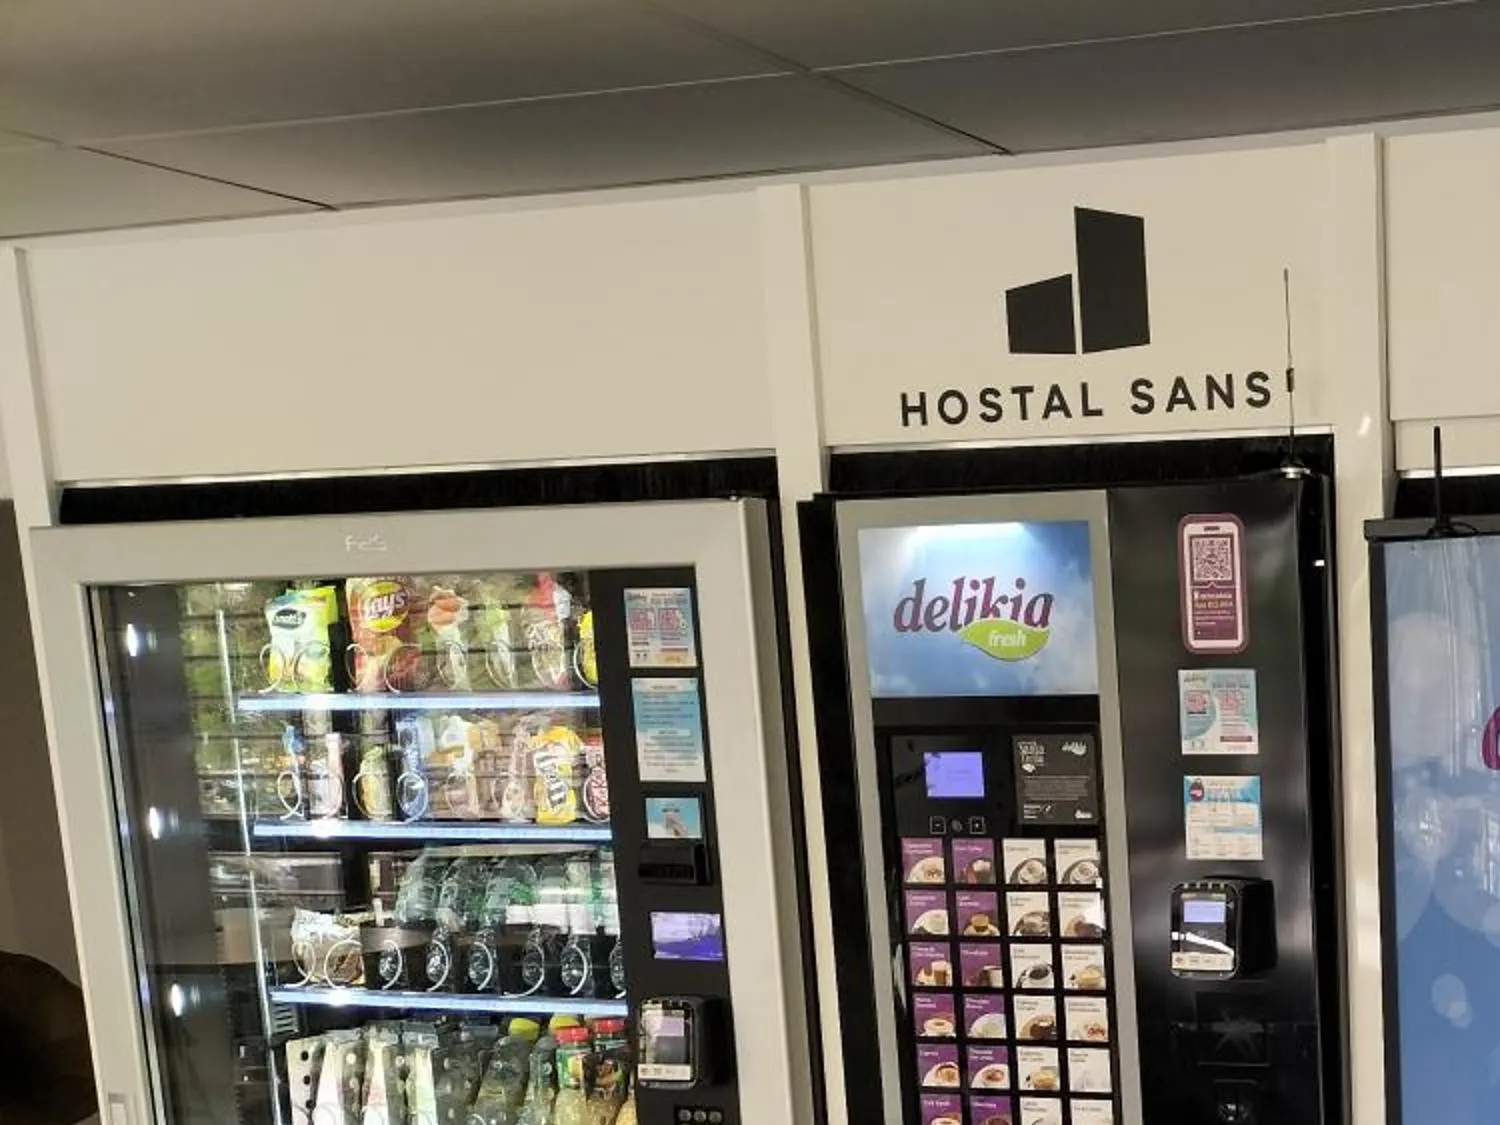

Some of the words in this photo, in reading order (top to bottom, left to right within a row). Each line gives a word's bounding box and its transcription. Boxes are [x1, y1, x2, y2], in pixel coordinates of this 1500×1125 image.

[900, 382, 1103, 427] HOSTAL
[1130, 371, 1271, 415] SANS
[894, 575, 1055, 633] delikia
[988, 629, 1027, 648] fresh
